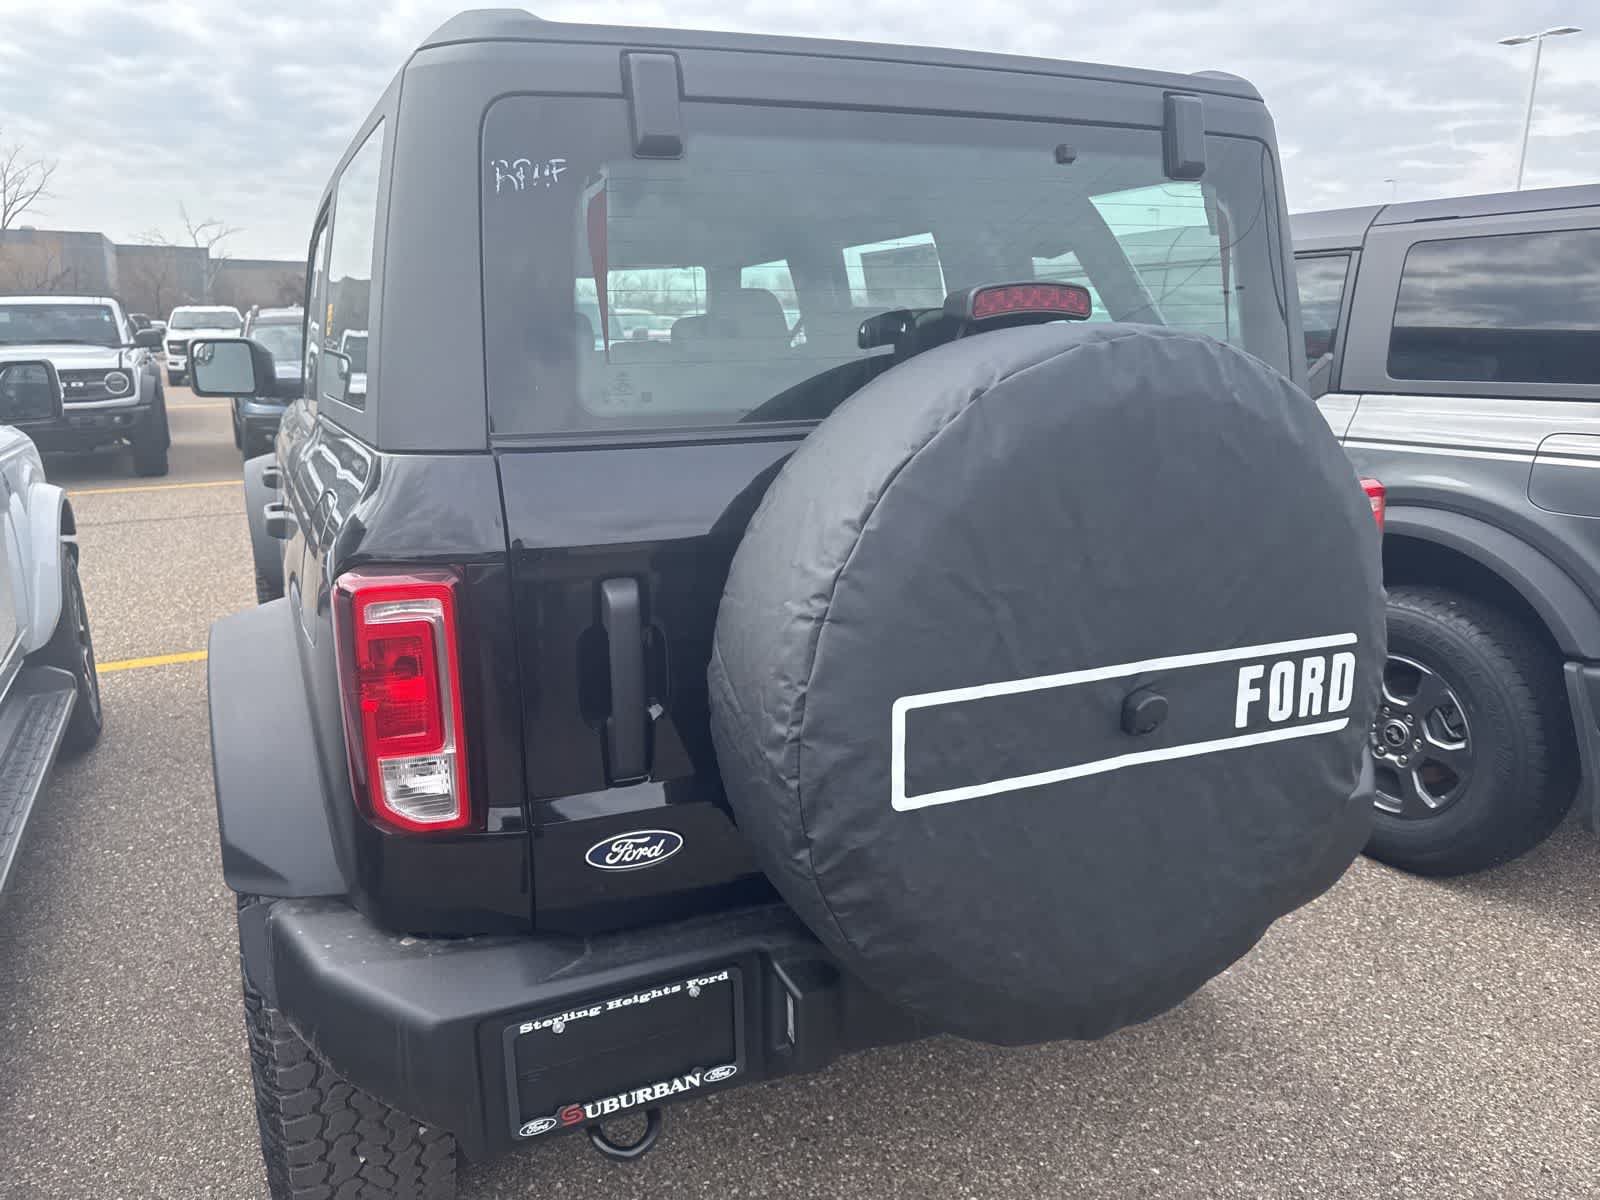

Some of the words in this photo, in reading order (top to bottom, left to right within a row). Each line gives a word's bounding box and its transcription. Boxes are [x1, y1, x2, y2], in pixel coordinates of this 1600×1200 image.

[1235, 652, 1356, 728] FORD
[605, 836, 665, 864] Ford
[520, 1006, 602, 1034] Sterling
[606, 984, 681, 1010] Heights
[686, 970, 728, 989] Ford
[561, 1073, 701, 1127] SUBURBAN
